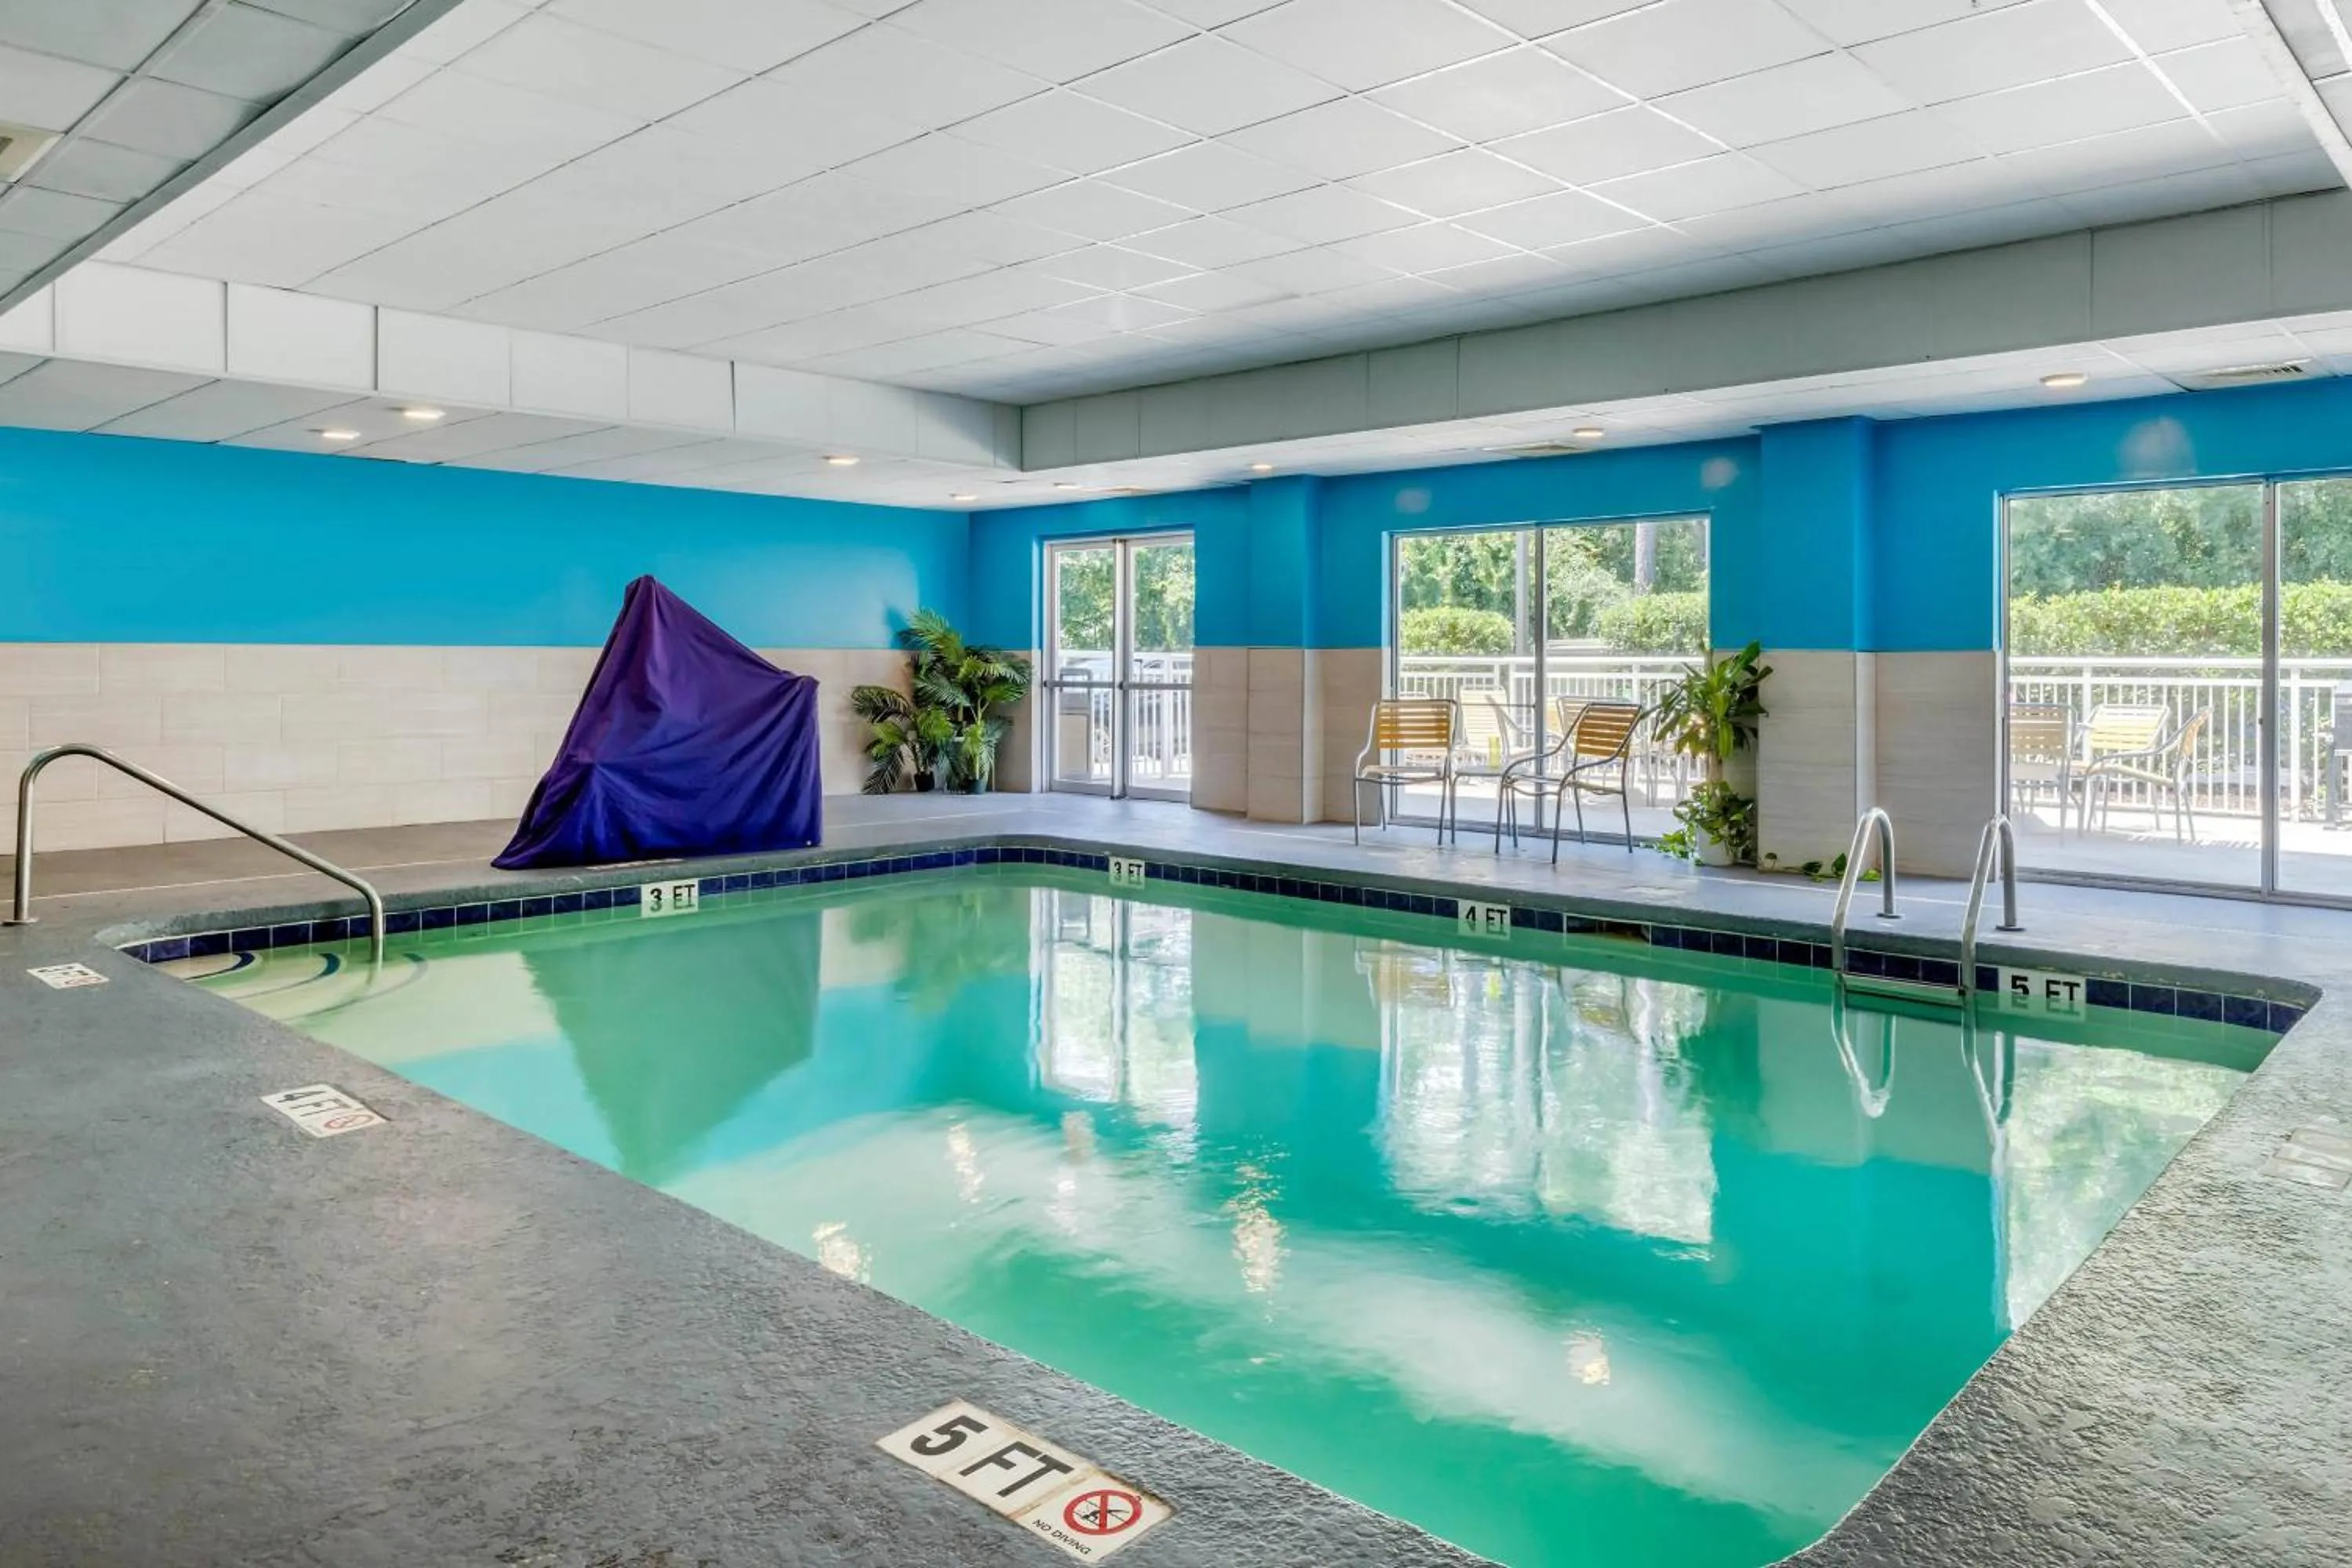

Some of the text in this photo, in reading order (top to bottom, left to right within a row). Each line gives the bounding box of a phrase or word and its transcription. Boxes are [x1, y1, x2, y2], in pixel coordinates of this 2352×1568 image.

[649, 884, 695, 902] 3 FT
[1486, 907, 1507, 924] FT
[2011, 974, 2081, 1001] 5 FT
[289, 1098, 352, 1117] FT
[910, 1415, 1075, 1498] 5 FT
[1033, 1519, 1092, 1555] NO DIVING
